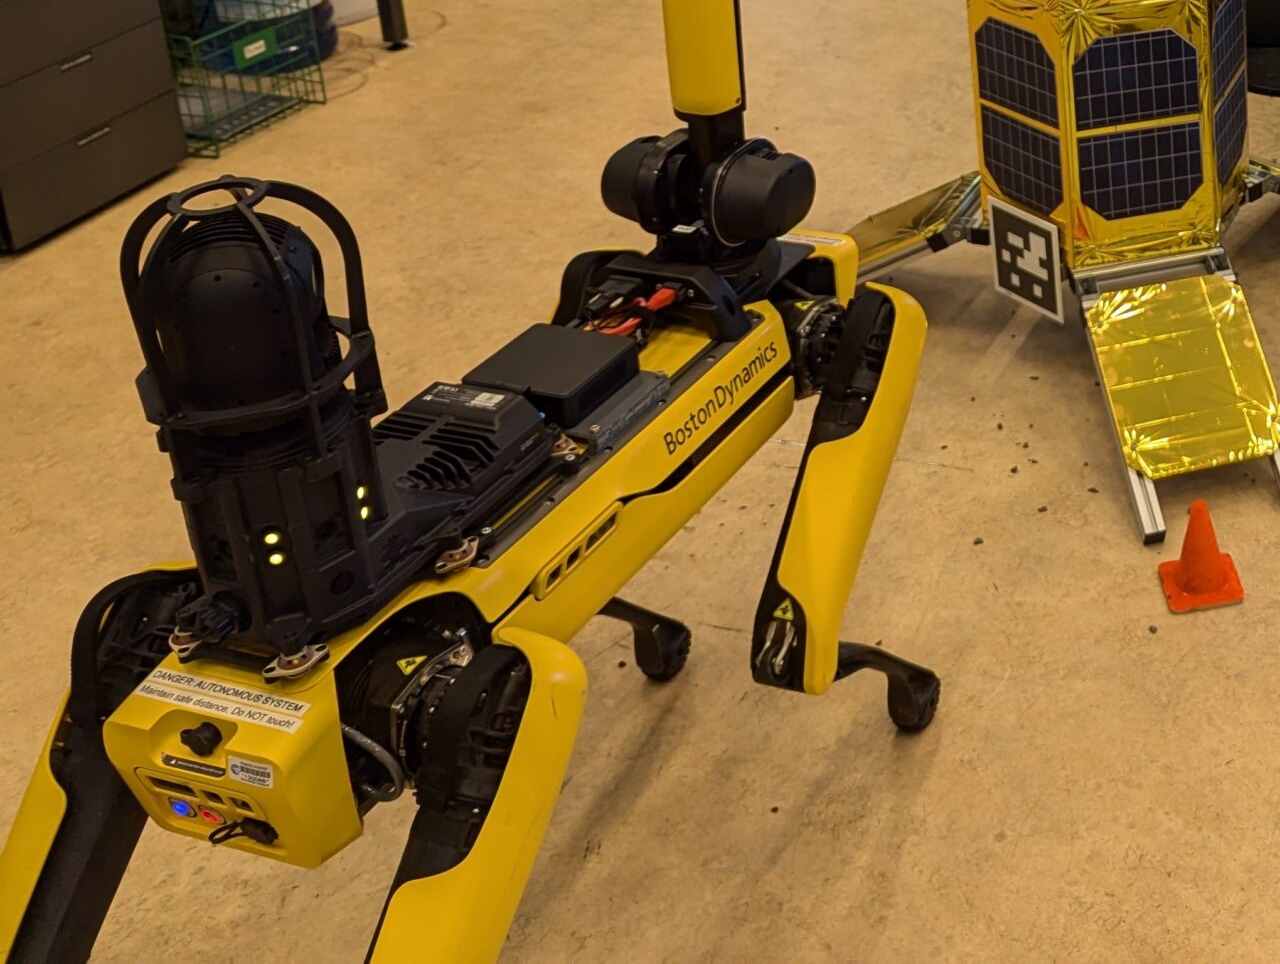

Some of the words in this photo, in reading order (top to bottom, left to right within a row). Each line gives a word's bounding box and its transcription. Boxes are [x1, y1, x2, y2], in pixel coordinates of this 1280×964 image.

[663, 341, 778, 456] BostonDynamics
[139, 684, 175, 700] Maintain
[174, 693, 193, 705] safe
[193, 697, 230, 713] distance.
[231, 707, 245, 718] Do
[247, 711, 268, 722] NOT
[266, 715, 296, 730] touch!
[152, 669, 196, 688] DANGER:
[194, 680, 262, 703] AUTONOMOUS
[262, 695, 304, 713] SYSTEM
